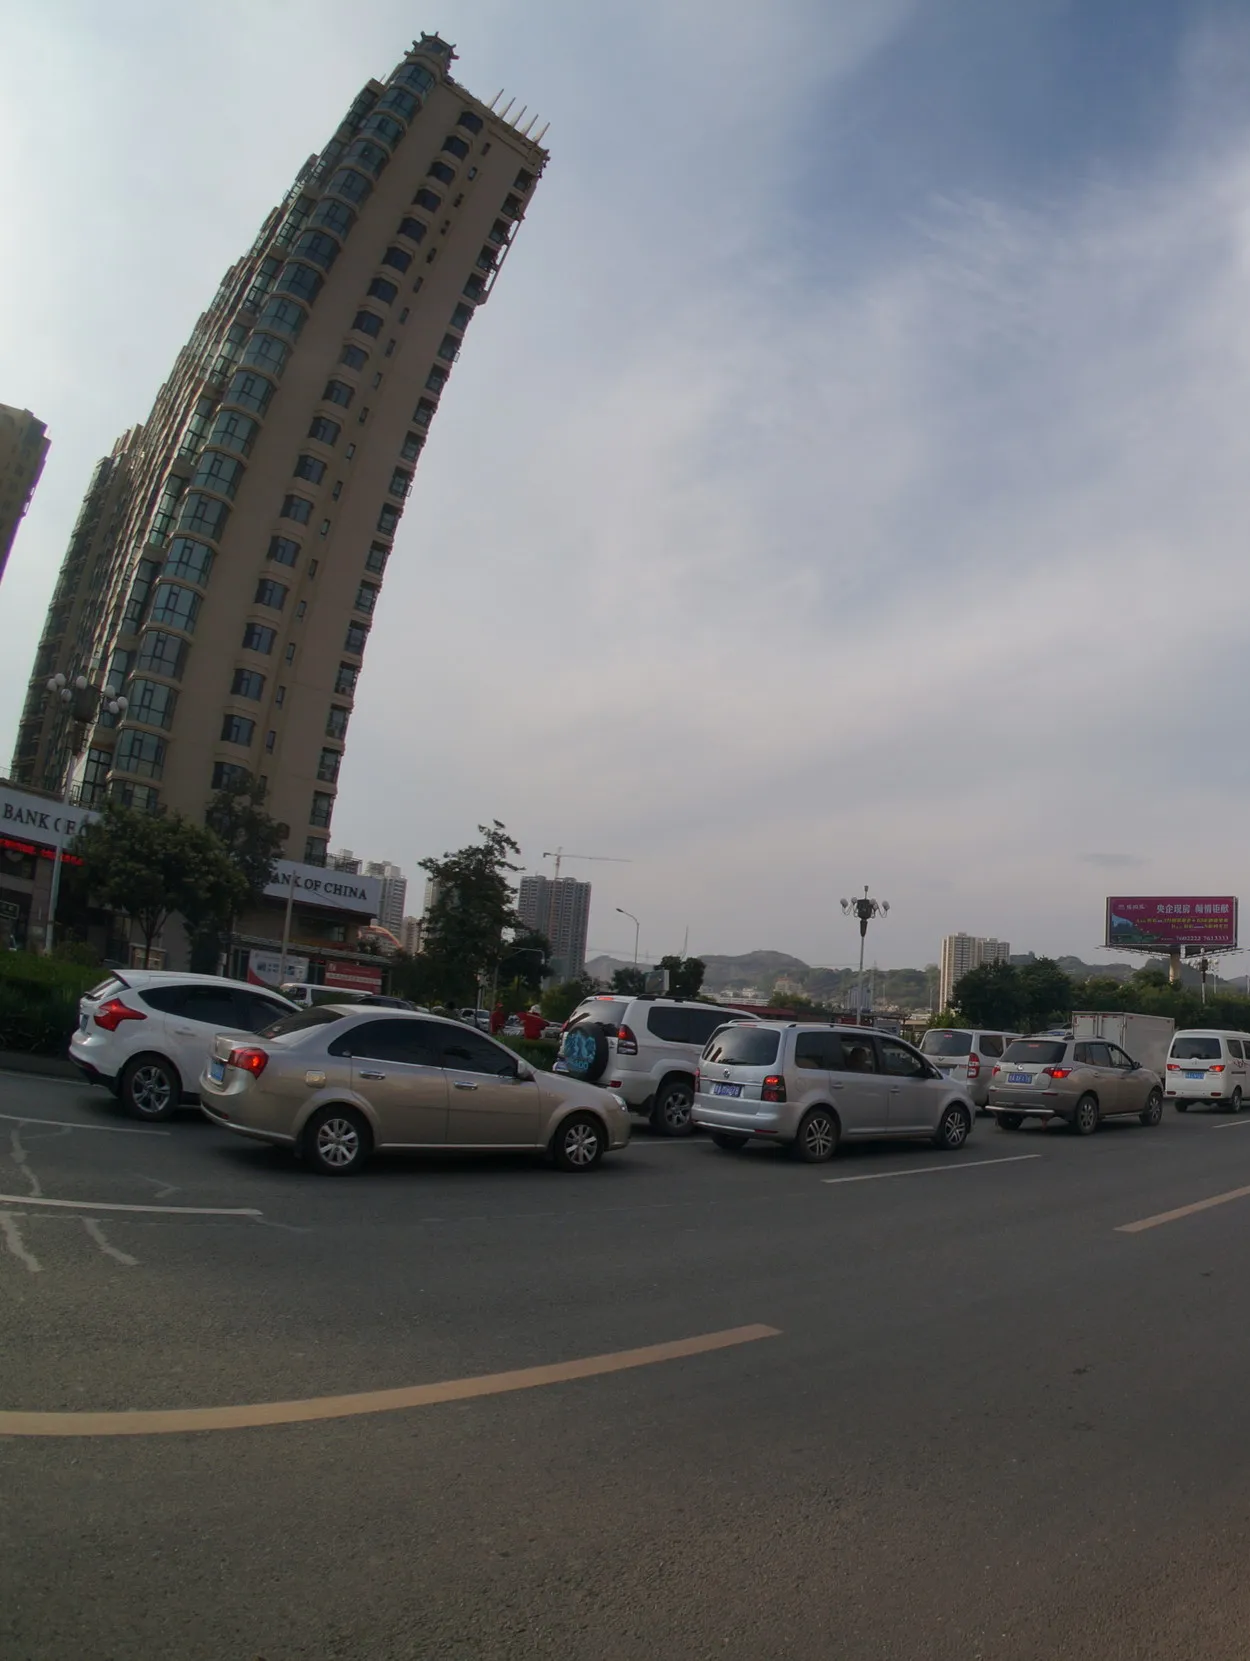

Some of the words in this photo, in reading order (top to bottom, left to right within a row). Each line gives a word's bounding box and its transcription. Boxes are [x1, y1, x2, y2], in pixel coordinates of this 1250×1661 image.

[3, 802, 51, 830] BANK
[304, 878, 322, 892] OF
[323, 882, 368, 900] CHINA
